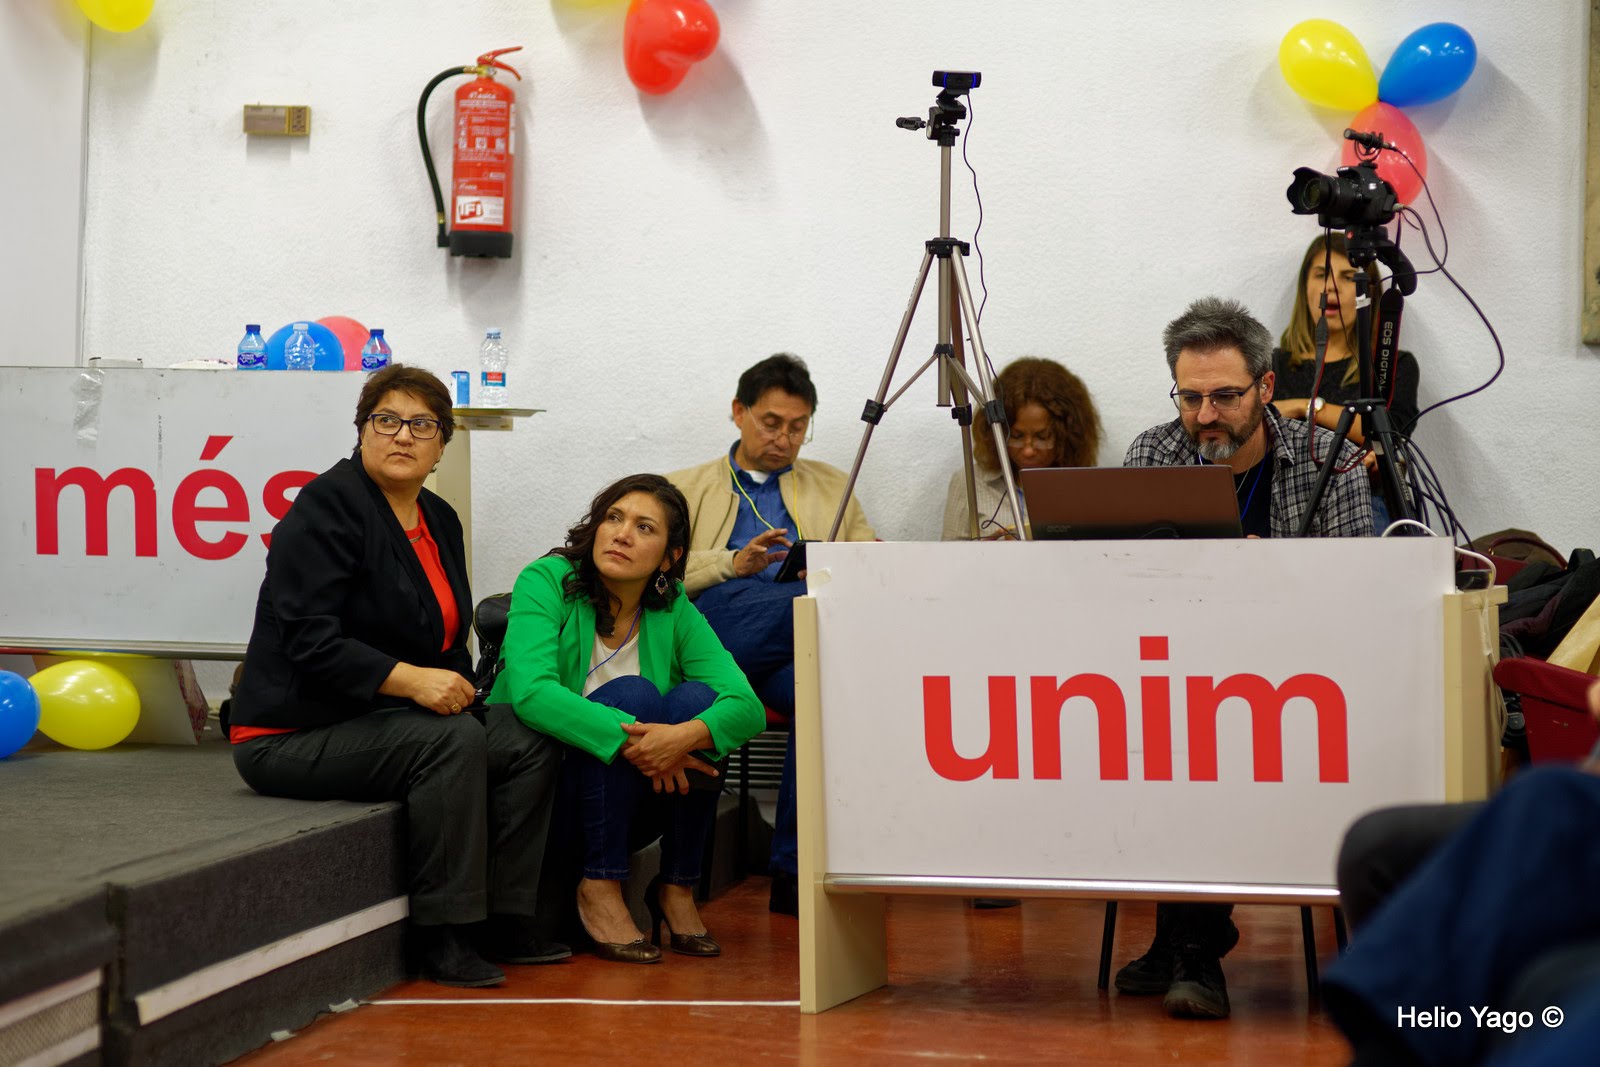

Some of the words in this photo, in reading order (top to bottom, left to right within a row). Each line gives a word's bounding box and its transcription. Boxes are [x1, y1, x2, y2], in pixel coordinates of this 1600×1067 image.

[1383, 321, 1393, 345] EOS
[1379, 349, 1390, 393] DIGITAL
[923, 636, 1348, 783] unim
